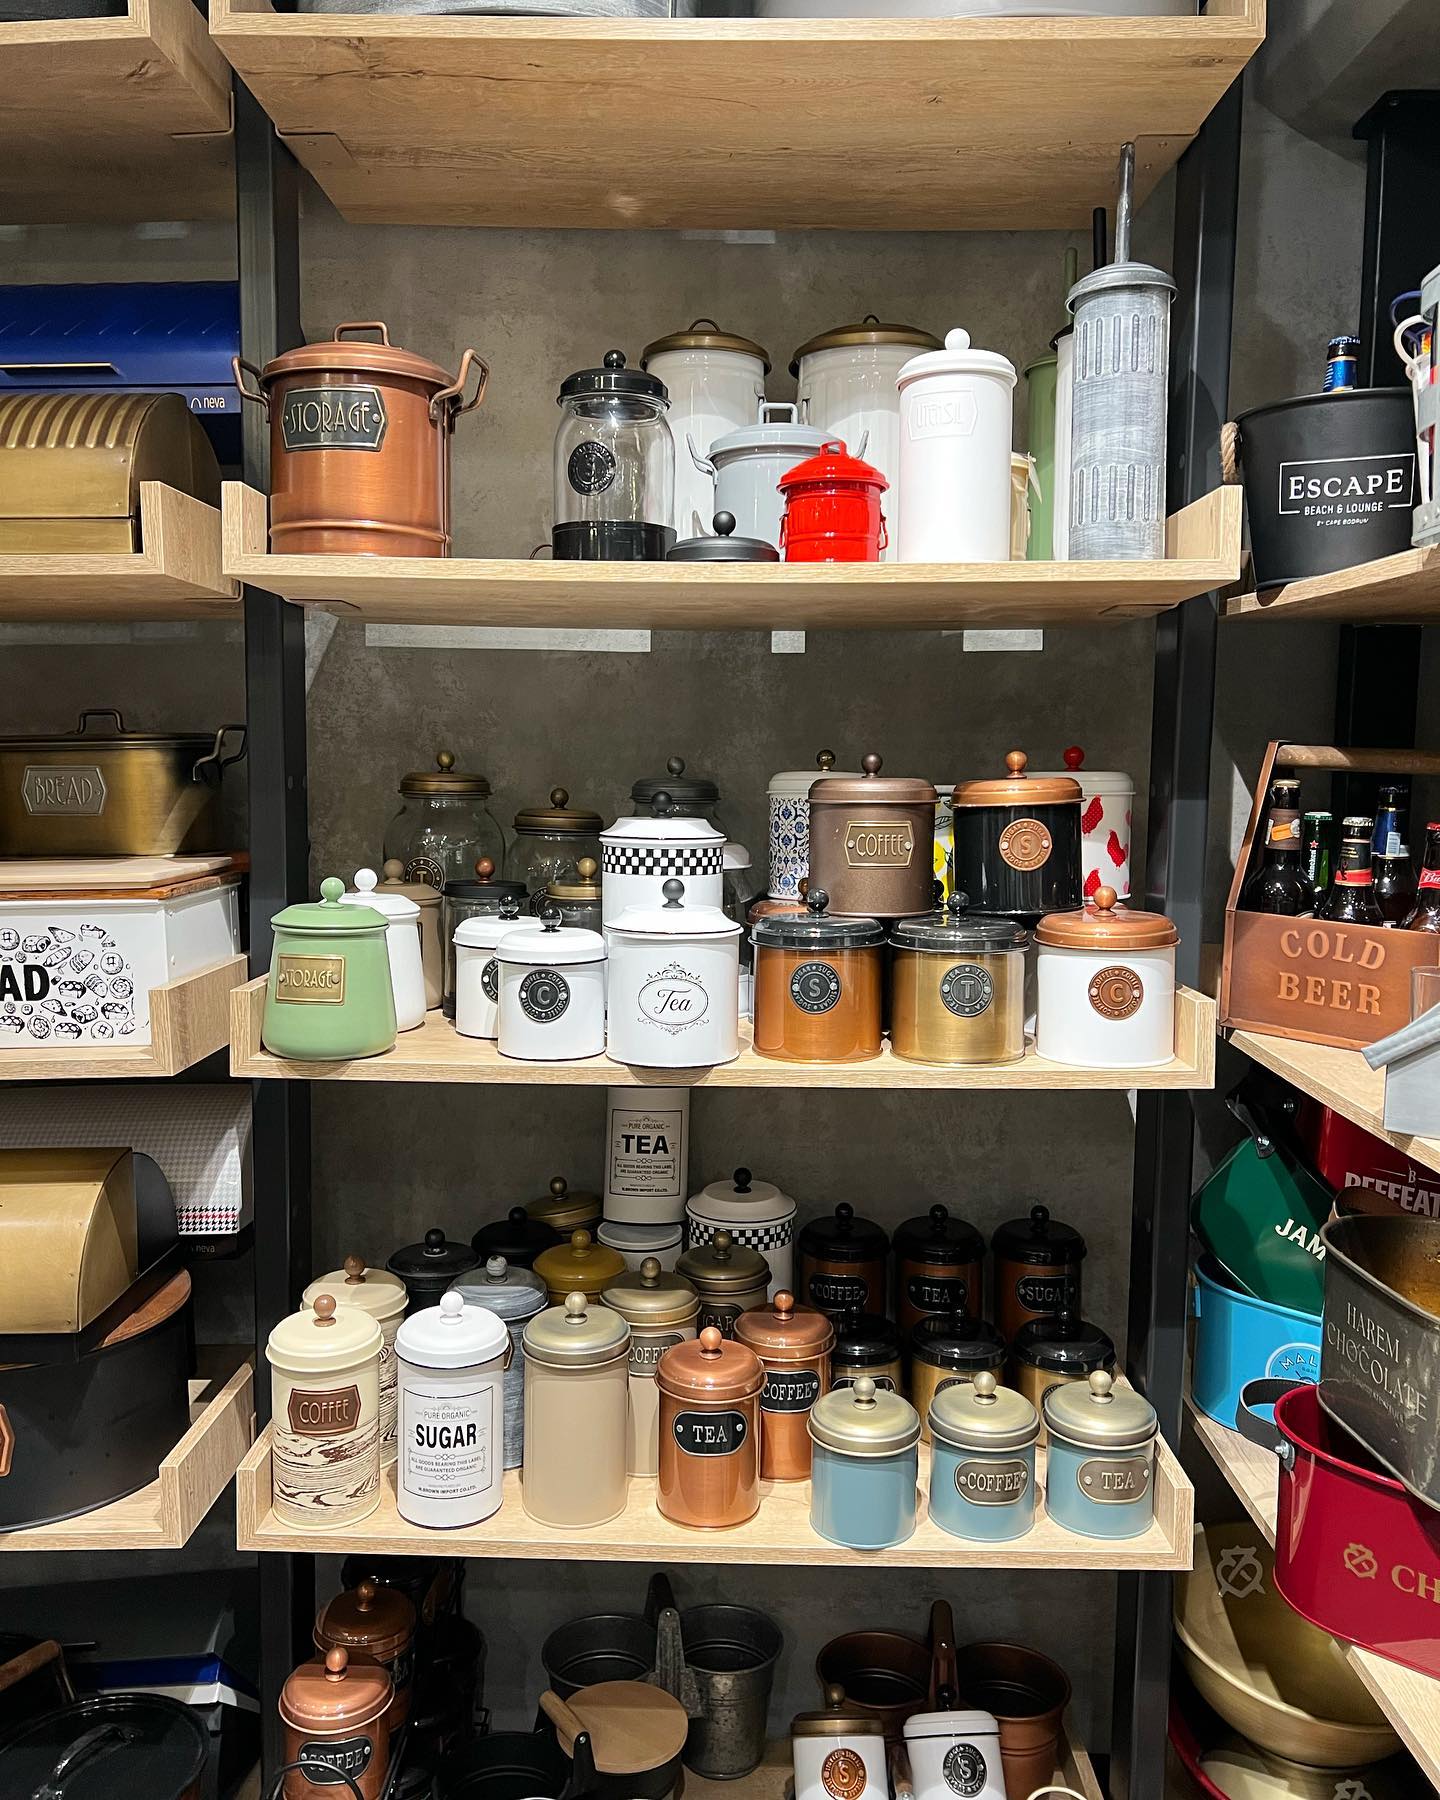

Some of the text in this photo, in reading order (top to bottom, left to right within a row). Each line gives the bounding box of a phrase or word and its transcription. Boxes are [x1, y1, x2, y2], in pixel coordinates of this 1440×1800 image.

[203, 397, 225, 408] neva
[290, 402, 370, 433] STORAGE
[1289, 468, 1404, 500] ESCAPE
[1304, 502, 1383, 515] BEACH & LOUNGE
[36, 776, 93, 806] BREAD
[856, 834, 904, 856] COFFEE
[1020, 835, 1032, 855] S
[1280, 929, 1386, 970] COLD
[284, 969, 332, 988] STORAGE
[523, 973, 541, 991] COFFEE
[792, 966, 811, 983] SUGAR
[818, 966, 837, 983] SUGAR
[945, 969, 960, 982] TEA
[1094, 970, 1113, 988] COFFEE
[537, 986, 550, 1005] C
[809, 978, 821, 997] S
[960, 980, 975, 999] T
[1110, 983, 1124, 1003] C
[1277, 971, 1381, 1016] BEER
[654, 988, 692, 1014] Tea
[621, 1134, 669, 1155] TEA
[196, 1245, 215, 1253] neva
[1275, 1218, 1327, 1262] JAM
[816, 1284, 860, 1301] COFFEE
[922, 1286, 950, 1303] TEA
[1347, 1302, 1399, 1364] HAREM
[1327, 1321, 1428, 1422] CHOCOLATE
[762, 1382, 812, 1401] COFFEE
[299, 1398, 349, 1424] COFFEE
[424, 1410, 470, 1420] PURE ORGANIC
[415, 1423, 476, 1449] SUGAR
[692, 1425, 728, 1444] TEA
[967, 1471, 1022, 1492] COFFEE
[1101, 1471, 1136, 1490] TEA
[309, 1748, 363, 1772] COFFEE
[960, 1759, 972, 1779] S
[839, 1761, 850, 1783] S
